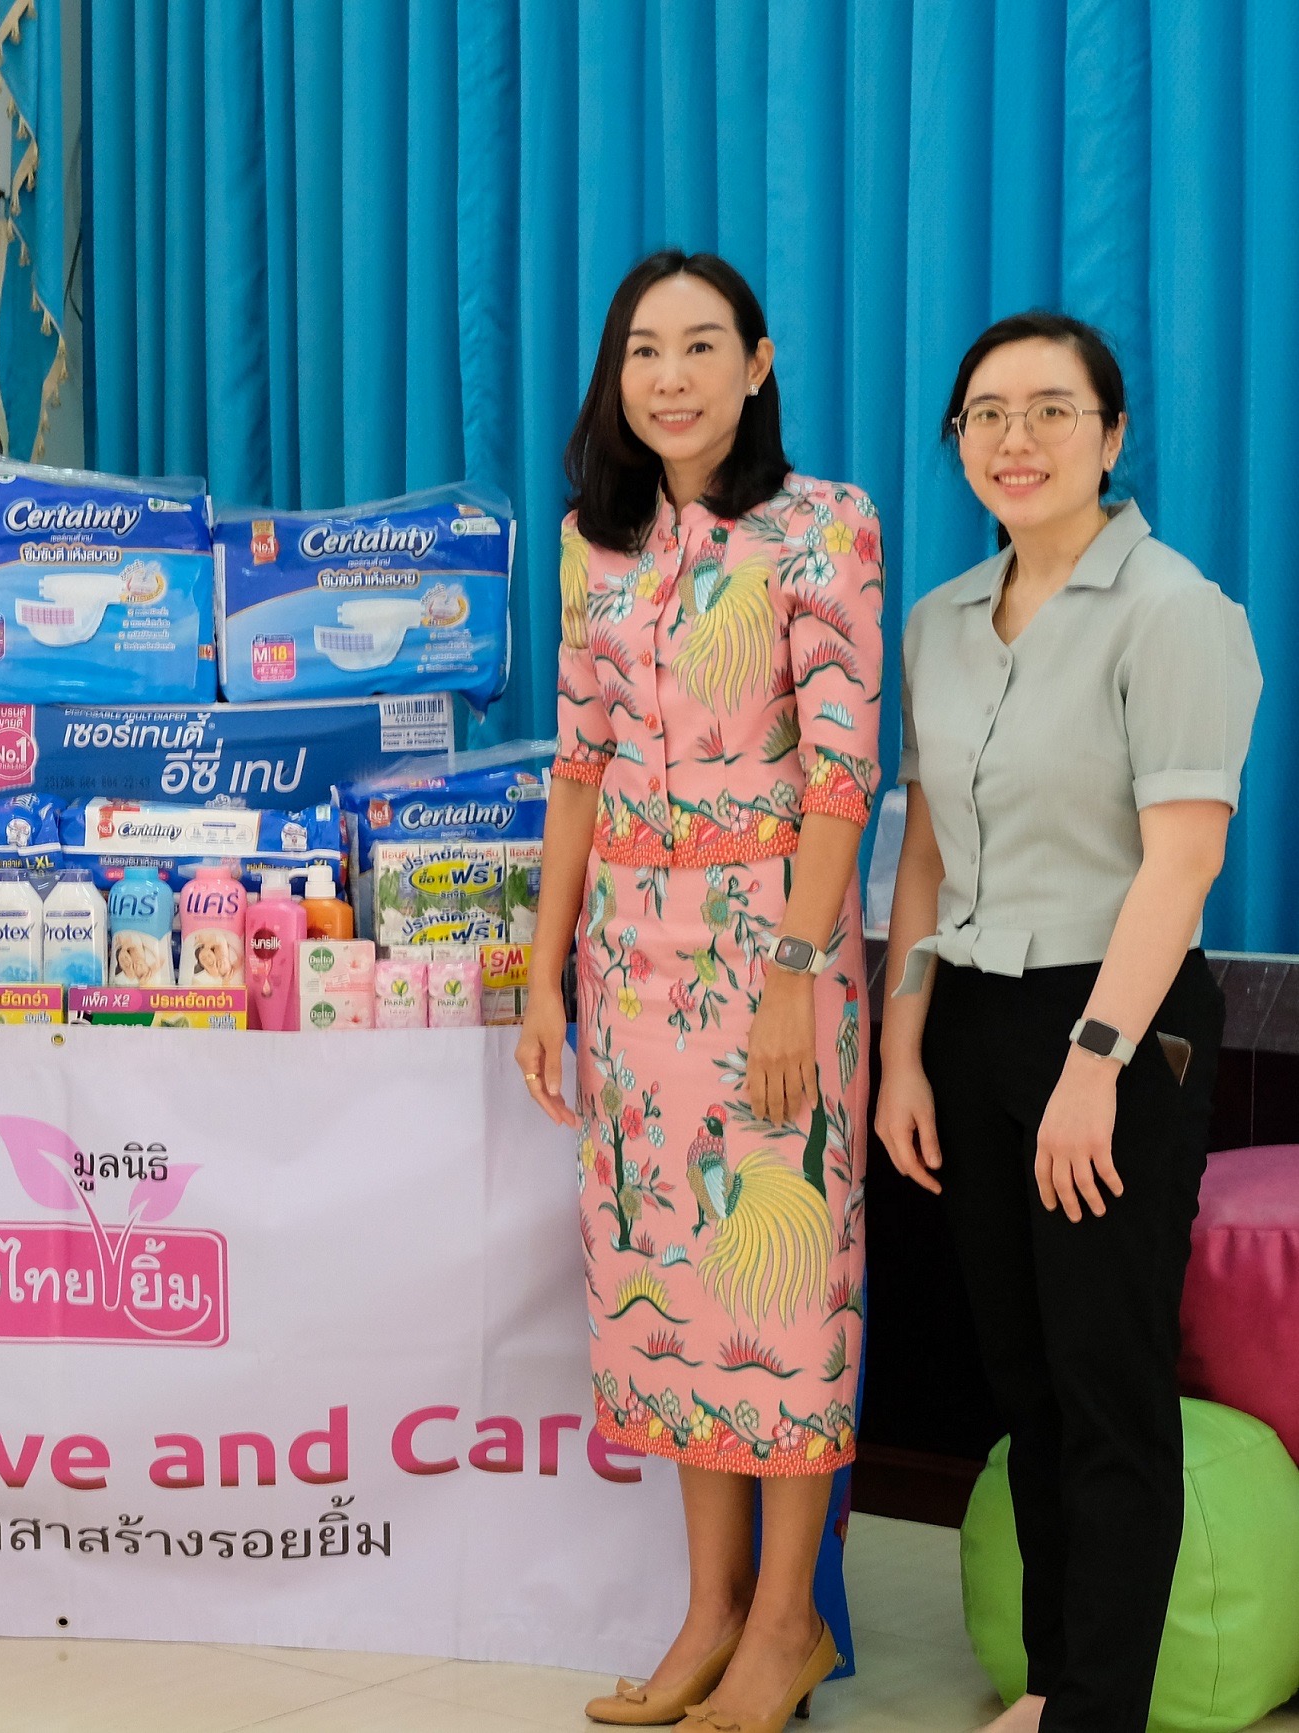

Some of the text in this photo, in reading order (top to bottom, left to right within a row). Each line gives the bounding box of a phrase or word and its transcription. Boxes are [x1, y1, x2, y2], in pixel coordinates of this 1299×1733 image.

[4, 500, 140, 536] Certainty
[252, 538, 276, 553] No.1
[300, 525, 438, 559] Certainty
[253, 647, 268, 663] M
[122, 711, 152, 722] ADULT
[153, 712, 187, 722] DIAPER
[63, 712, 211, 749] เซอร์เทนตี้
[160, 738, 307, 795] อีซี่ เทป
[401, 801, 516, 830] Certainty
[117, 820, 182, 840] Certainty
[493, 866, 503, 883] 1
[108, 890, 159, 916] แคร์
[186, 890, 240, 915] แคร์
[43, 921, 94, 941] Protex
[250, 936, 282, 950] sunsilk
[309, 953, 334, 967] Dettol
[81, 991, 234, 1009] แพ็ค X2 ประหยัดกว่า
[310, 1007, 336, 1022] Dettol
[73, 1140, 170, 1192] มูลนิธิ
[129, 1237, 200, 1311] ยิ้ม
[147, 1403, 350, 1490] and
[390, 1404, 648, 1485] Care
